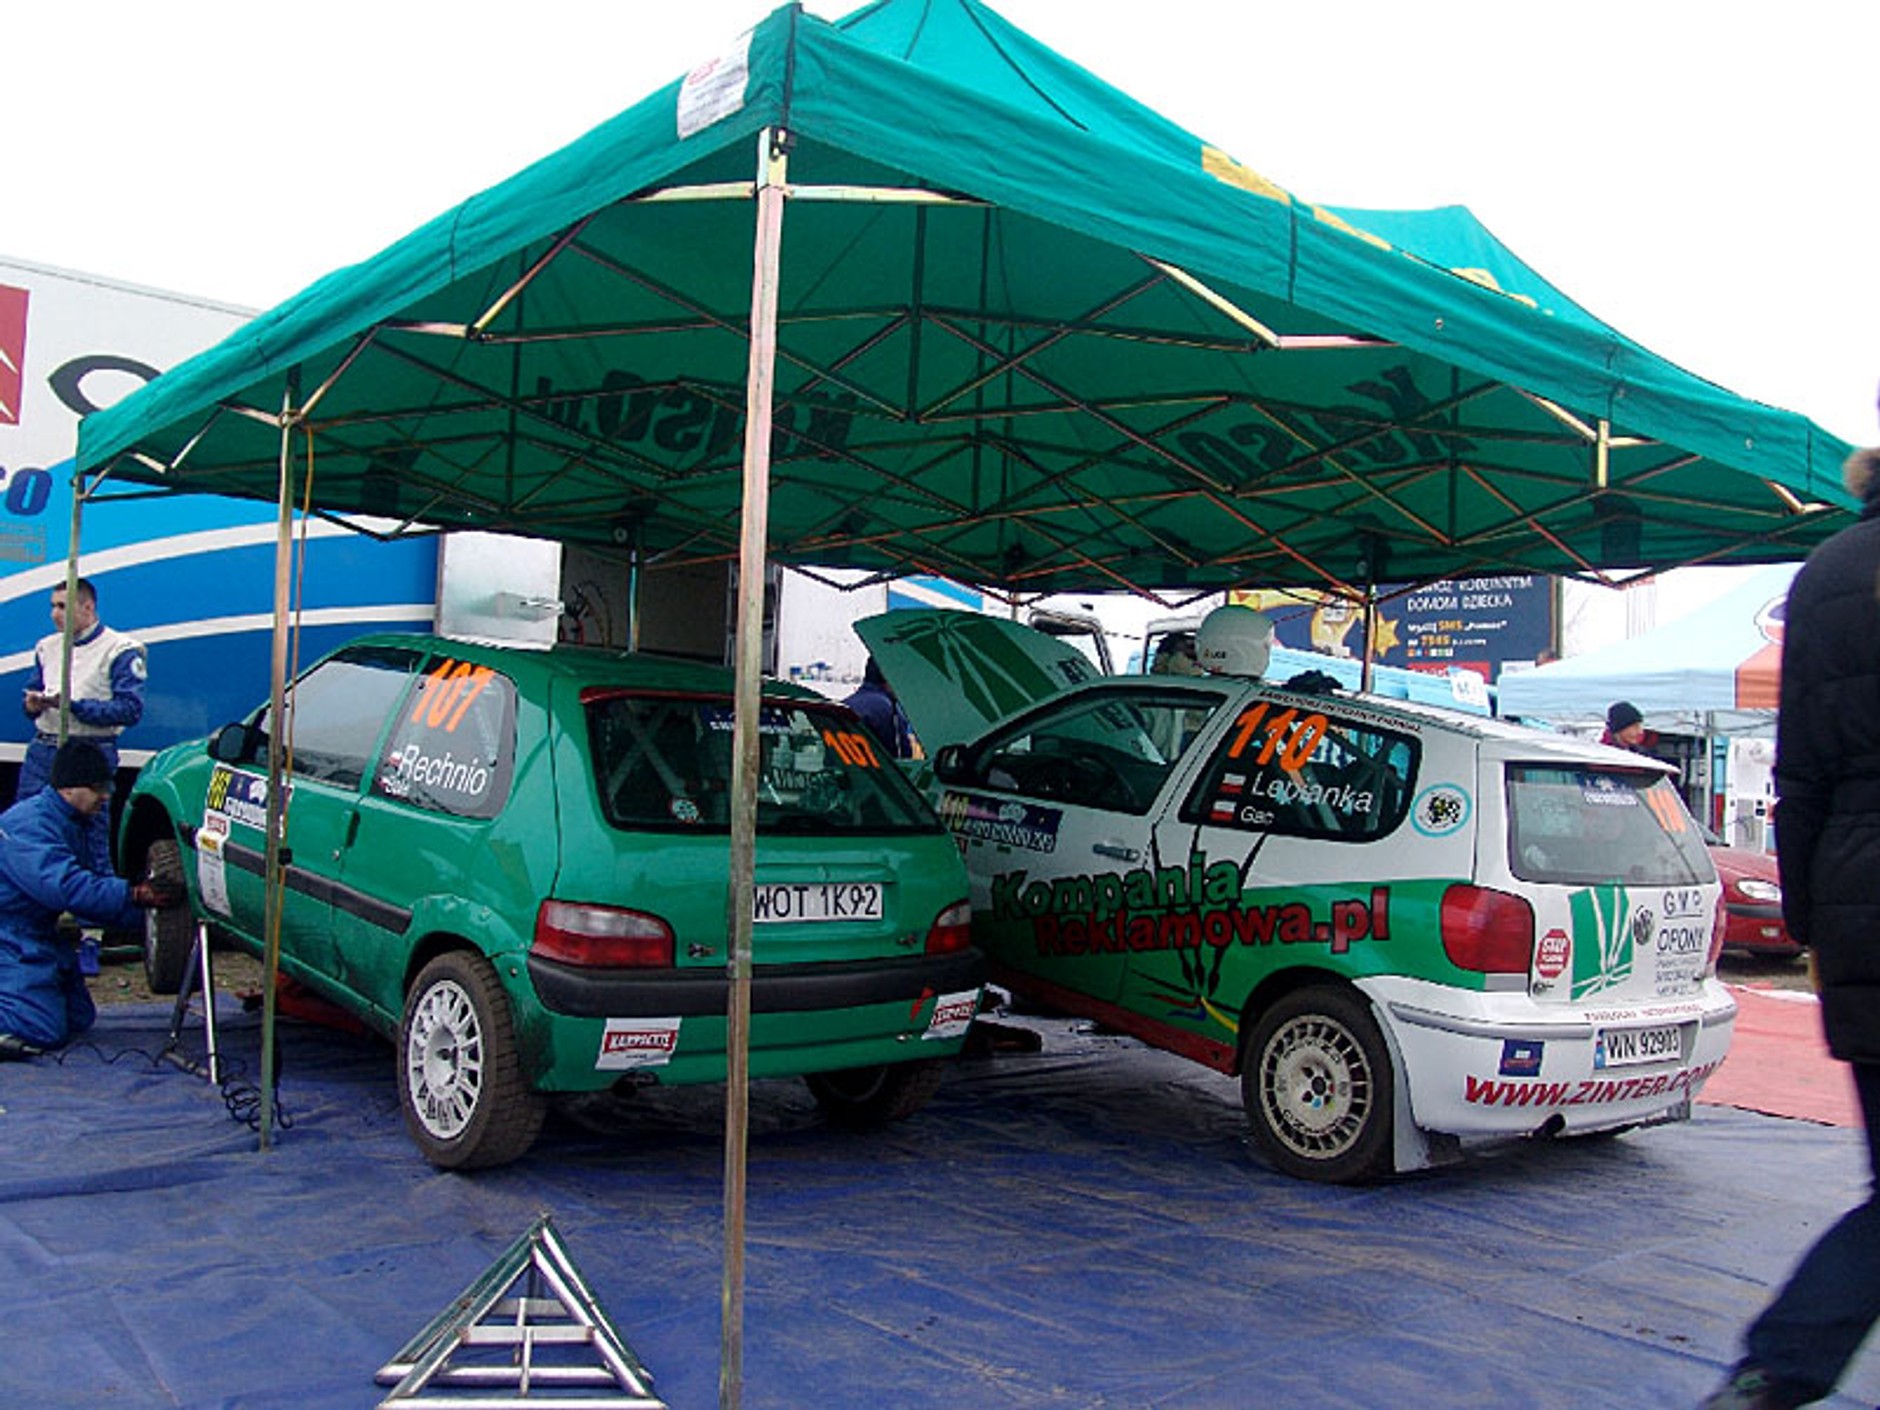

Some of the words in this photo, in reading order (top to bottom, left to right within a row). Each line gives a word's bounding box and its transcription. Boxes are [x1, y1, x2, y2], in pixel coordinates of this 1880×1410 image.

[1408, 596, 1458, 612] DOMOM
[1462, 594, 1512, 610] DZIECKA
[410, 658, 495, 732] 107
[822, 729, 880, 768] 107
[1228, 701, 1329, 771] 110
[397, 744, 487, 795] Rechnio
[753, 885, 809, 918] WOT
[821, 885, 878, 916] 1K92
[992, 851, 1241, 921] Kompania
[1033, 886, 1391, 956] Reklamowa.pl
